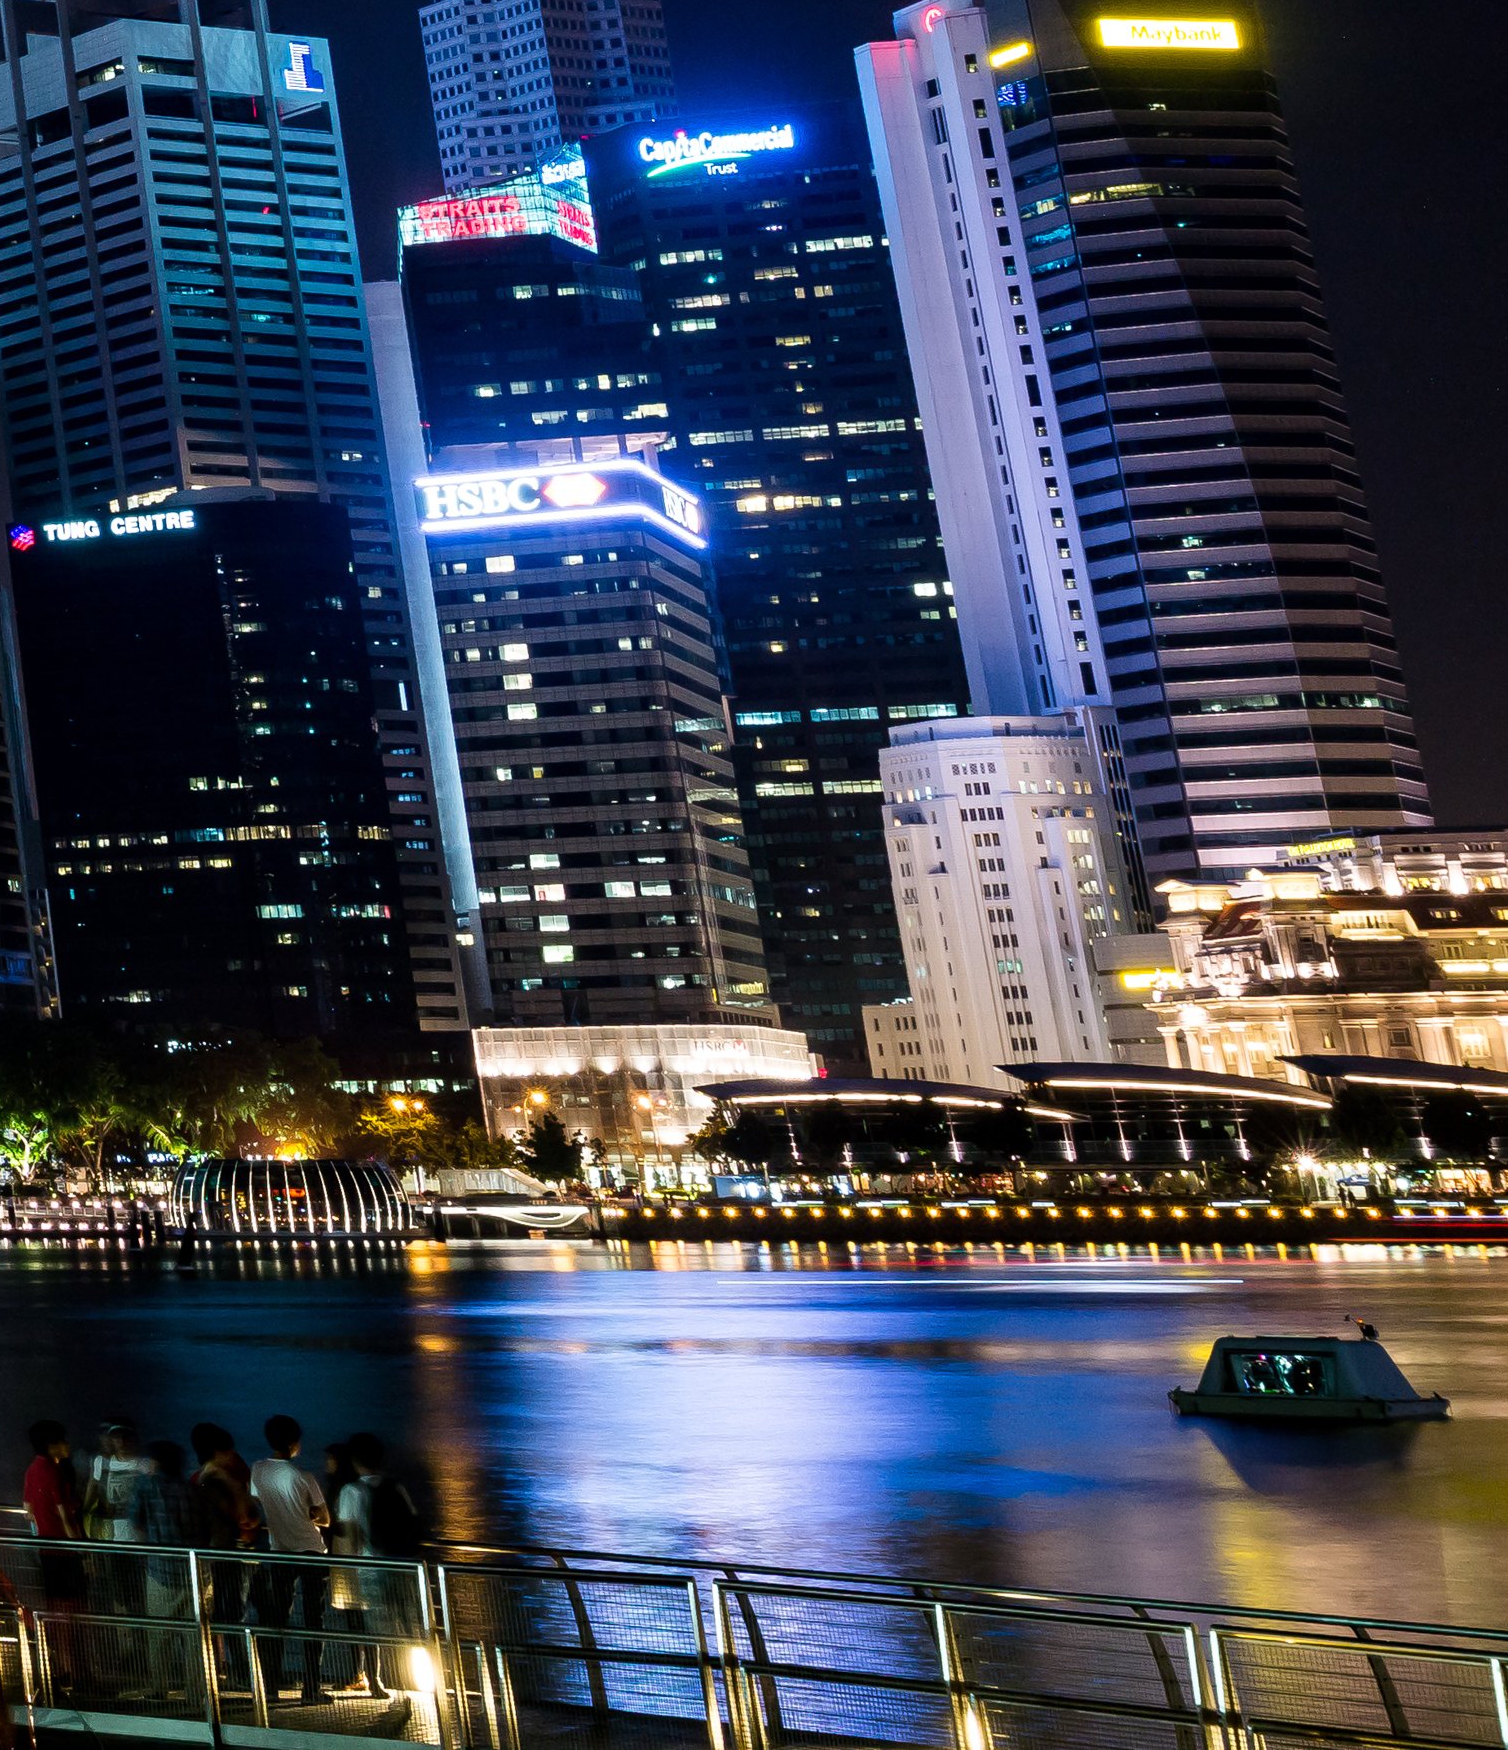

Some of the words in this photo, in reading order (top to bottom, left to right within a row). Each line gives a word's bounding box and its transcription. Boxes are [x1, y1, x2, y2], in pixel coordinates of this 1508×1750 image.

[1131, 26, 1222, 44] Maybank
[639, 124, 794, 164] CapitaCommercial
[704, 162, 738, 175] Trust
[419, 196, 520, 220] STRAITS
[422, 215, 528, 237] TRADING
[423, 476, 540, 519] HSBC
[43, 520, 100, 541] TUNG
[110, 510, 195, 536] CENTRE
